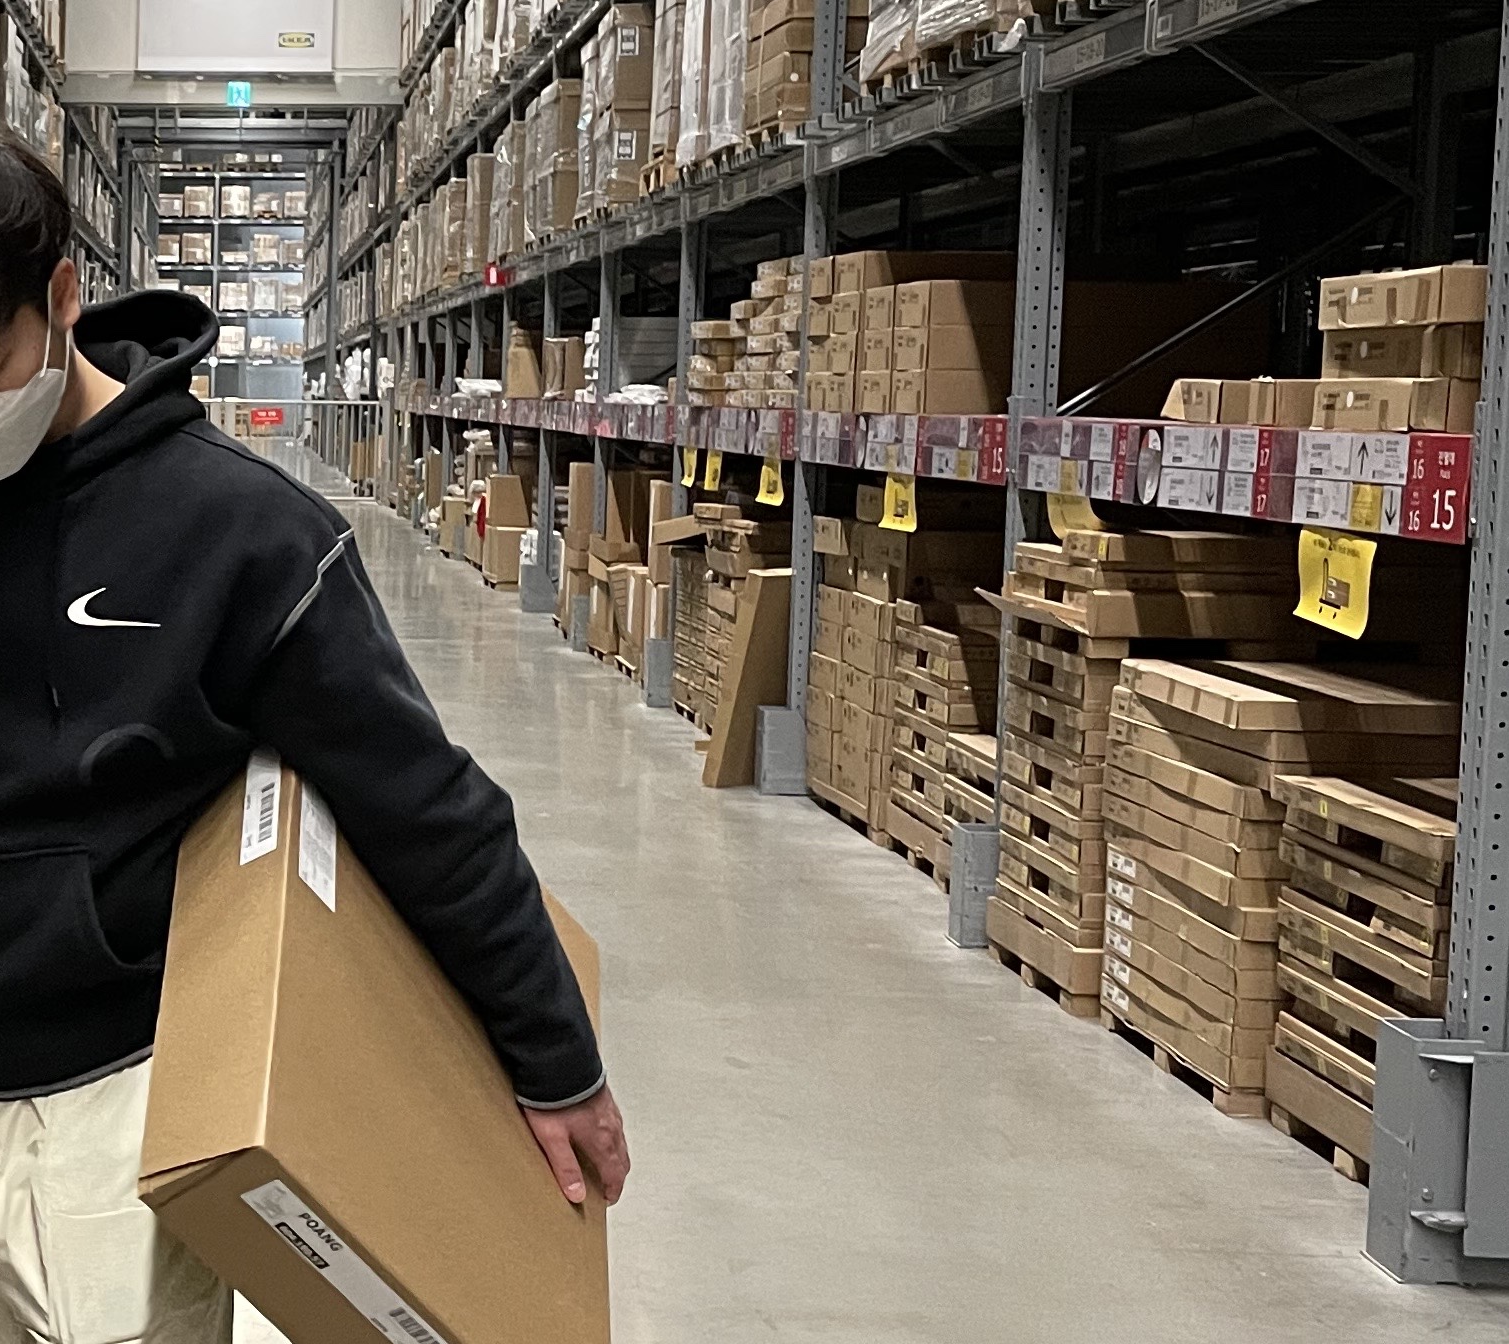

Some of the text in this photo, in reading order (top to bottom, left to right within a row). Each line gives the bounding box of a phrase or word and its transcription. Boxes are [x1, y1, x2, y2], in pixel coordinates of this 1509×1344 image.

[1412, 458, 1425, 479] 16
[1407, 509, 1421, 532] 16
[1430, 488, 1457, 531] 15
